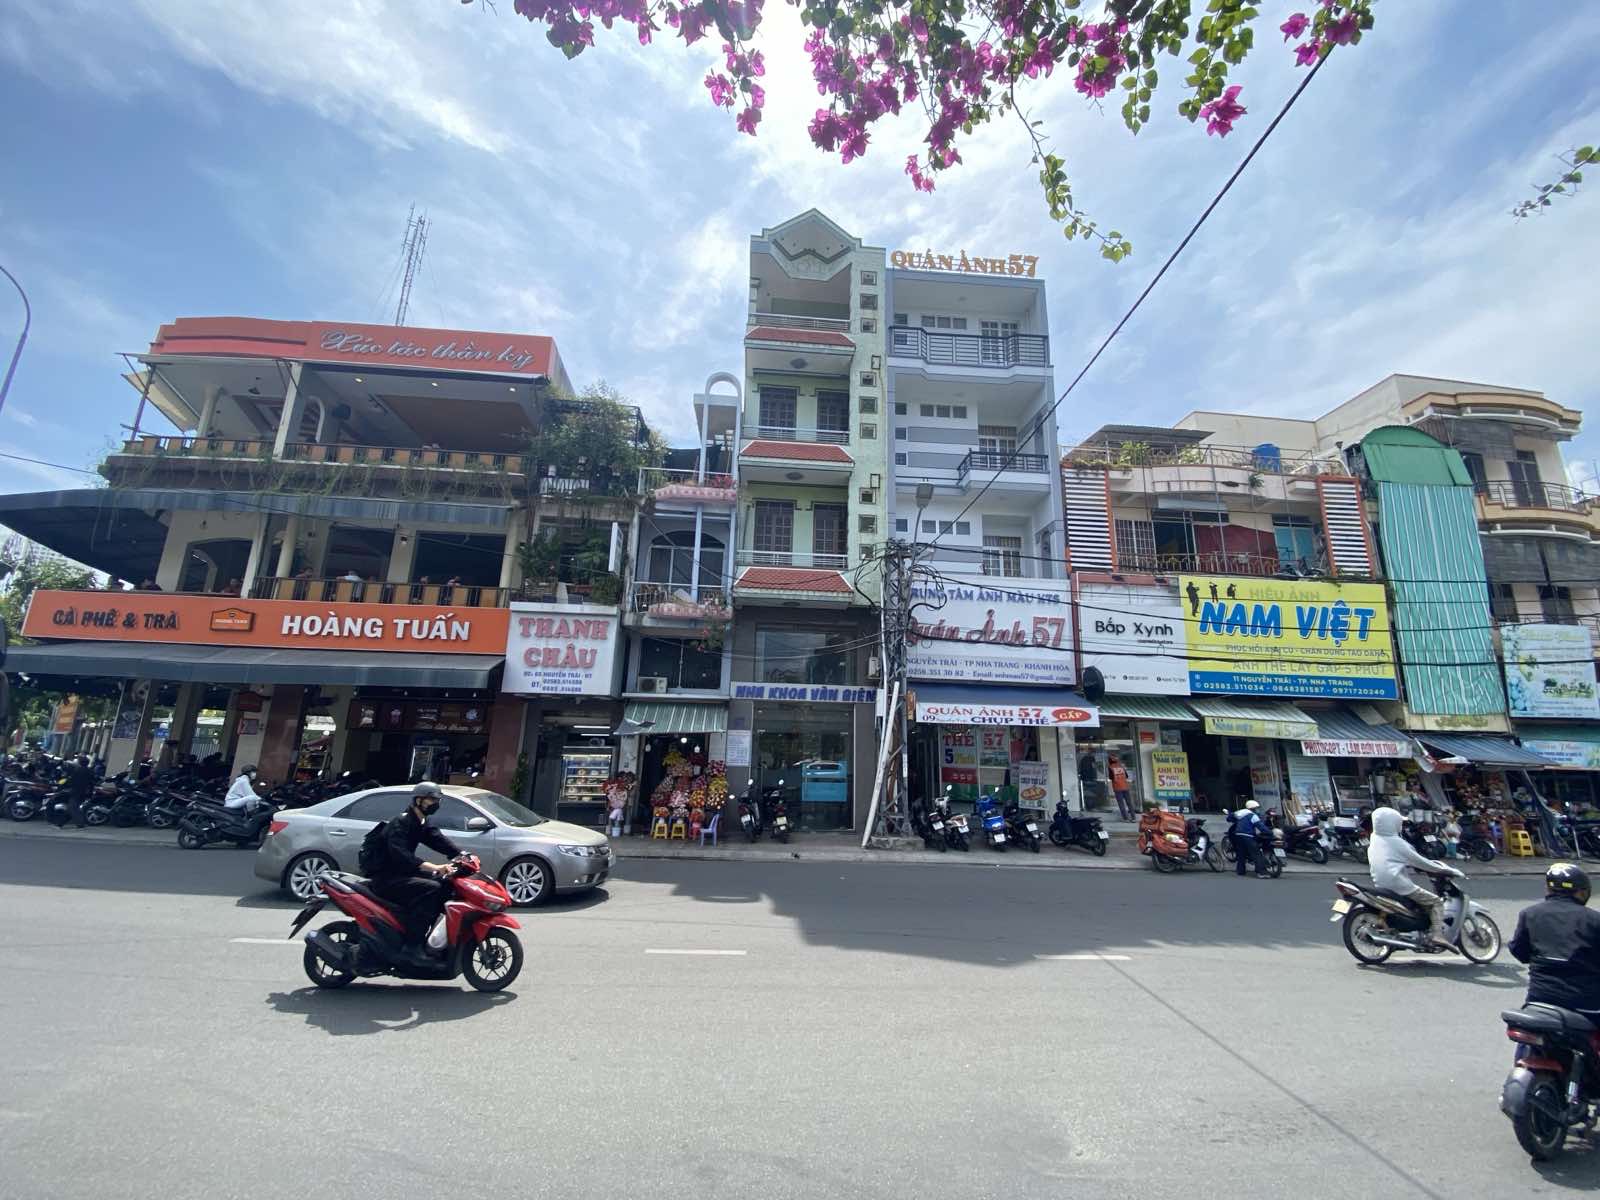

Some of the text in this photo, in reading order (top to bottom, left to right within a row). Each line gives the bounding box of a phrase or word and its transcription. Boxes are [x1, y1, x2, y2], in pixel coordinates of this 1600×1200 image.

[891, 248, 1039, 277] QUÁN ẢNH 57
[387, 340, 428, 357] tác
[911, 587, 945, 600] RUNG
[948, 587, 975, 601] TÂM
[977, 586, 1002, 602] ẢNH
[52, 606, 178, 630] CÀ PHÊ & TRÀ
[281, 611, 471, 641] HOÀNG TUẤN
[1199, 600, 1376, 647] NAM VIỆT
[519, 617, 609, 640] THANH
[1032, 616, 1065, 647] 57
[1095, 616, 1173, 637] Bắp Xynh
[524, 643, 598, 669] CHÂU
[994, 661, 1019, 669] TRANG
[1327, 679, 1354, 687] TRANG
[736, 685, 765, 698] NHA
[768, 686, 807, 700] KHOA
[922, 714, 936, 722] 09
[927, 706, 1043, 717] QUÁN ẢNH 57
[1059, 710, 1083, 720] GẤP
[971, 716, 1014, 726] CHỤP
[944, 748, 954, 764] 5
[1158, 775, 1165, 787] 5
